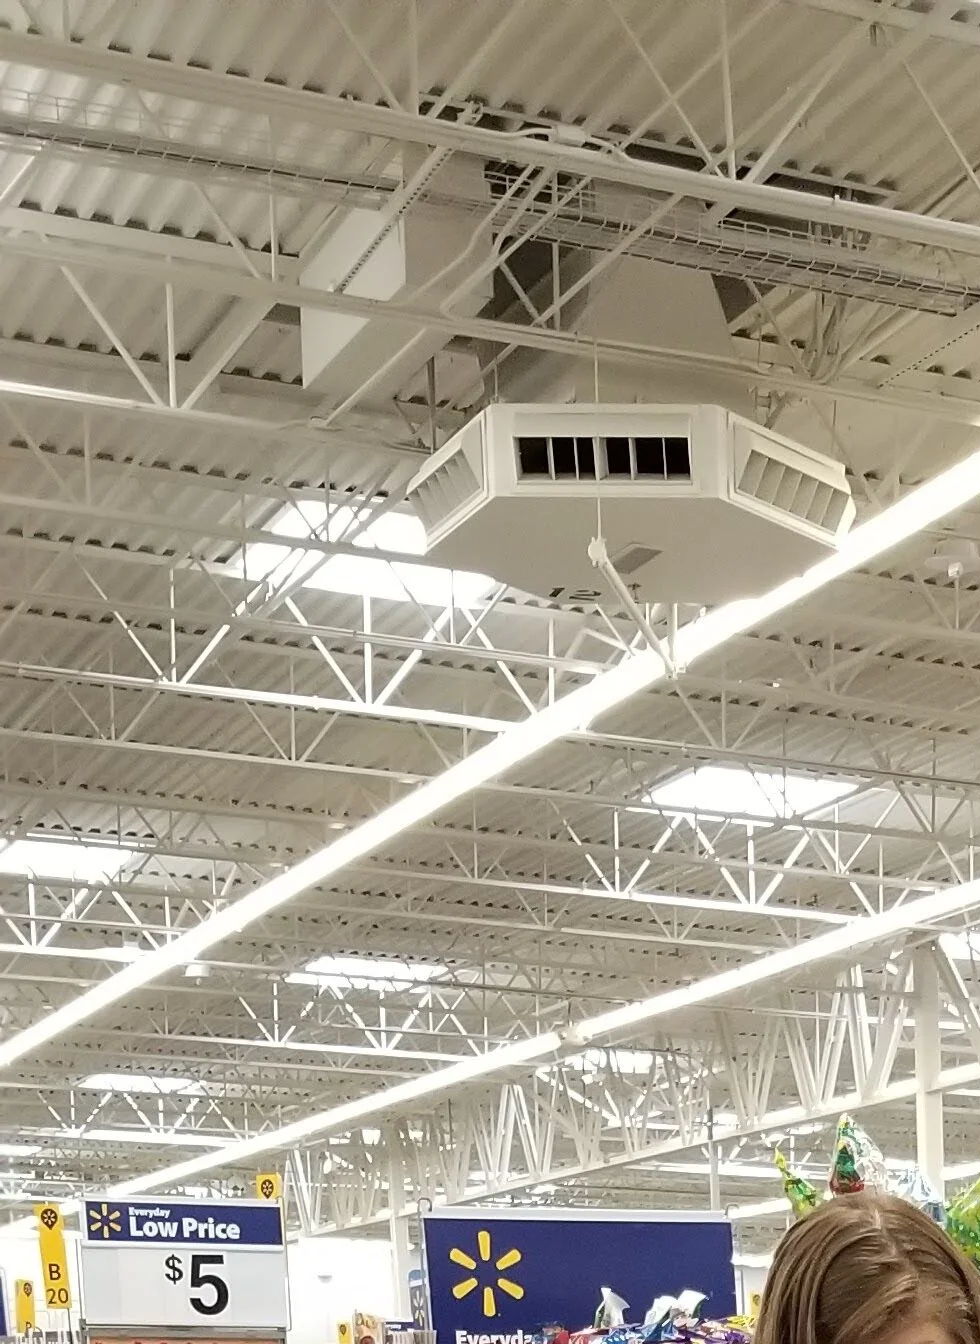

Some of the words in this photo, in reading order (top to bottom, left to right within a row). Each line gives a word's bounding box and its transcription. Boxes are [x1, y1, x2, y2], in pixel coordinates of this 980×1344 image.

[128, 1206, 171, 1219] Everyday
[129, 1218, 178, 1238] Low
[182, 1218, 241, 1239] Price
[48, 1264, 61, 1281] B
[47, 1288, 69, 1304] 20
